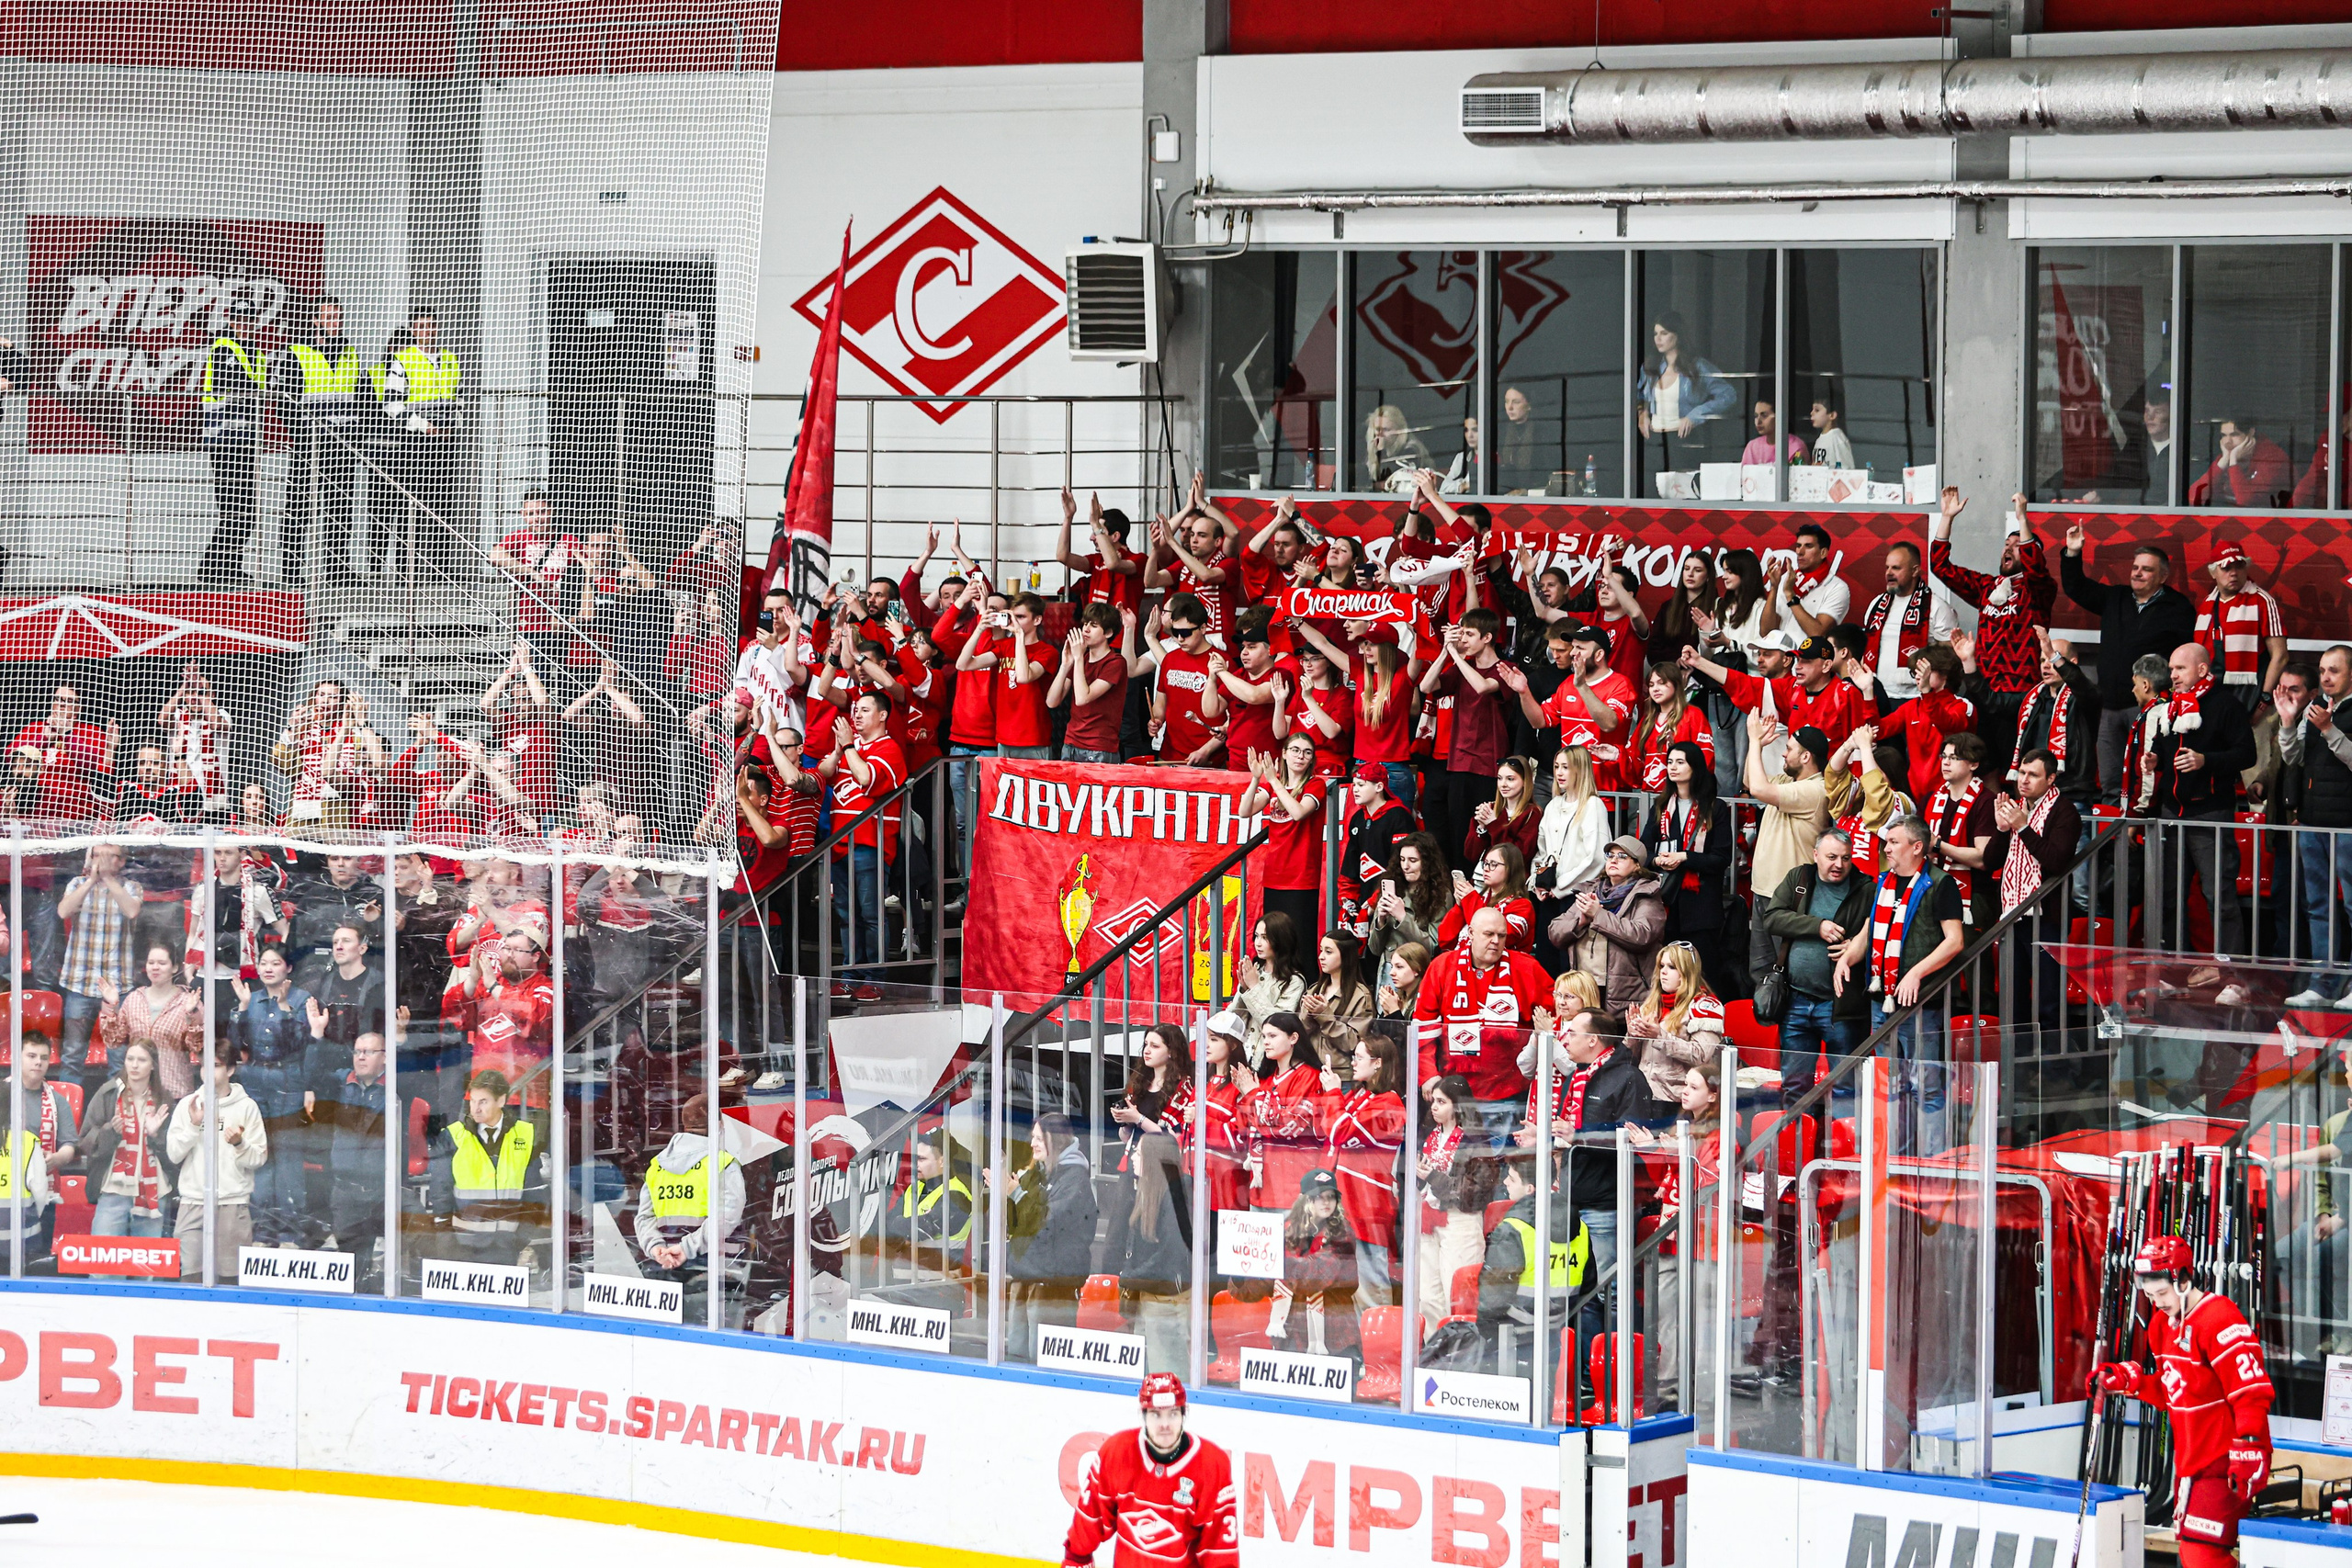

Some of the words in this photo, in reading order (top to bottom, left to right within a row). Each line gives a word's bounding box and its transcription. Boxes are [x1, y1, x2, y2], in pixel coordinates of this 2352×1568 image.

[1290, 587, 1405, 621] Спартак
[771, 1150, 899, 1221] СООЛЬИКИ
[775, 1167, 796, 1183] ЛЕДО
[657, 1184, 695, 1201] 2338
[61, 1245, 177, 1267] OLIMPBET
[243, 1256, 350, 1282] MHL.KHL.RU
[425, 1269, 525, 1297] MHL.KHL.RU
[588, 1282, 679, 1313] MHL.KHL.RU
[851, 1310, 947, 1341] MHL.KHL.RU
[1041, 1336, 1141, 1367] MHL.KHL.RU
[1245, 1359, 1349, 1391] MHL.KHL.RU
[2235, 1352, 2265, 1381] 22
[1440, 1390, 1521, 1413] Ростелеком
[401, 1371, 926, 1475] TICKETS.SPARTAK.RU
[2228, 1450, 2263, 1461] ОСКВА
